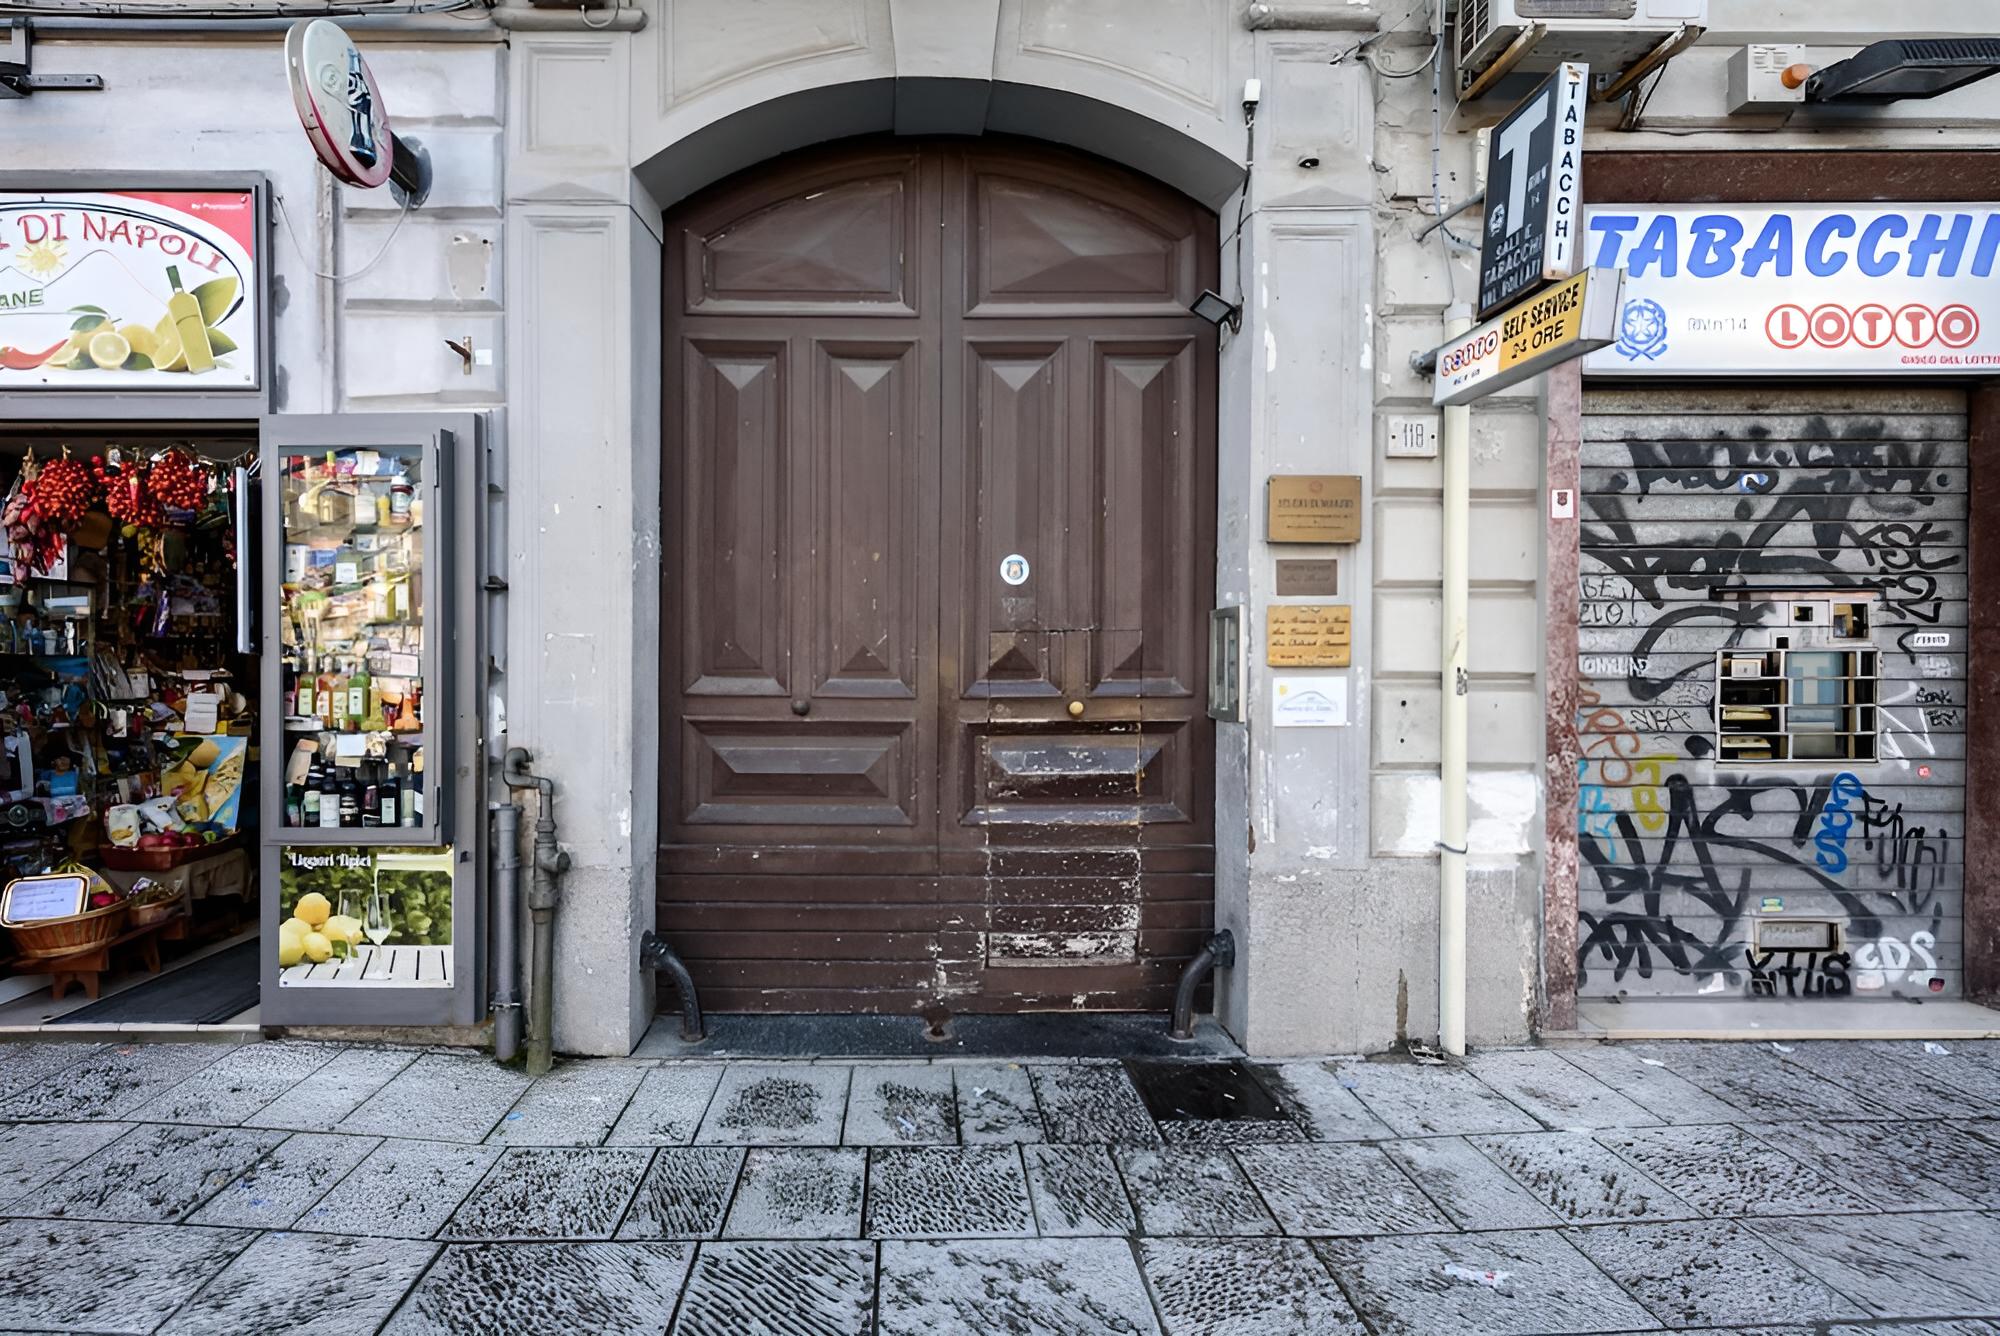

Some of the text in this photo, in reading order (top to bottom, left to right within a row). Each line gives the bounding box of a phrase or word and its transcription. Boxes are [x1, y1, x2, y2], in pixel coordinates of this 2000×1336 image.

[1498, 90, 1550, 235] T
[1554, 81, 1581, 261] TABACCHI
[17, 212, 68, 245] DI
[82, 211, 225, 274] NAPOLI
[1590, 213, 2000, 279] TABACCHI
[1502, 310, 1528, 344] SELF
[1532, 319, 1565, 350] ORE
[1765, 303, 1980, 349] LOTTO
[1403, 422, 1424, 448] 118
